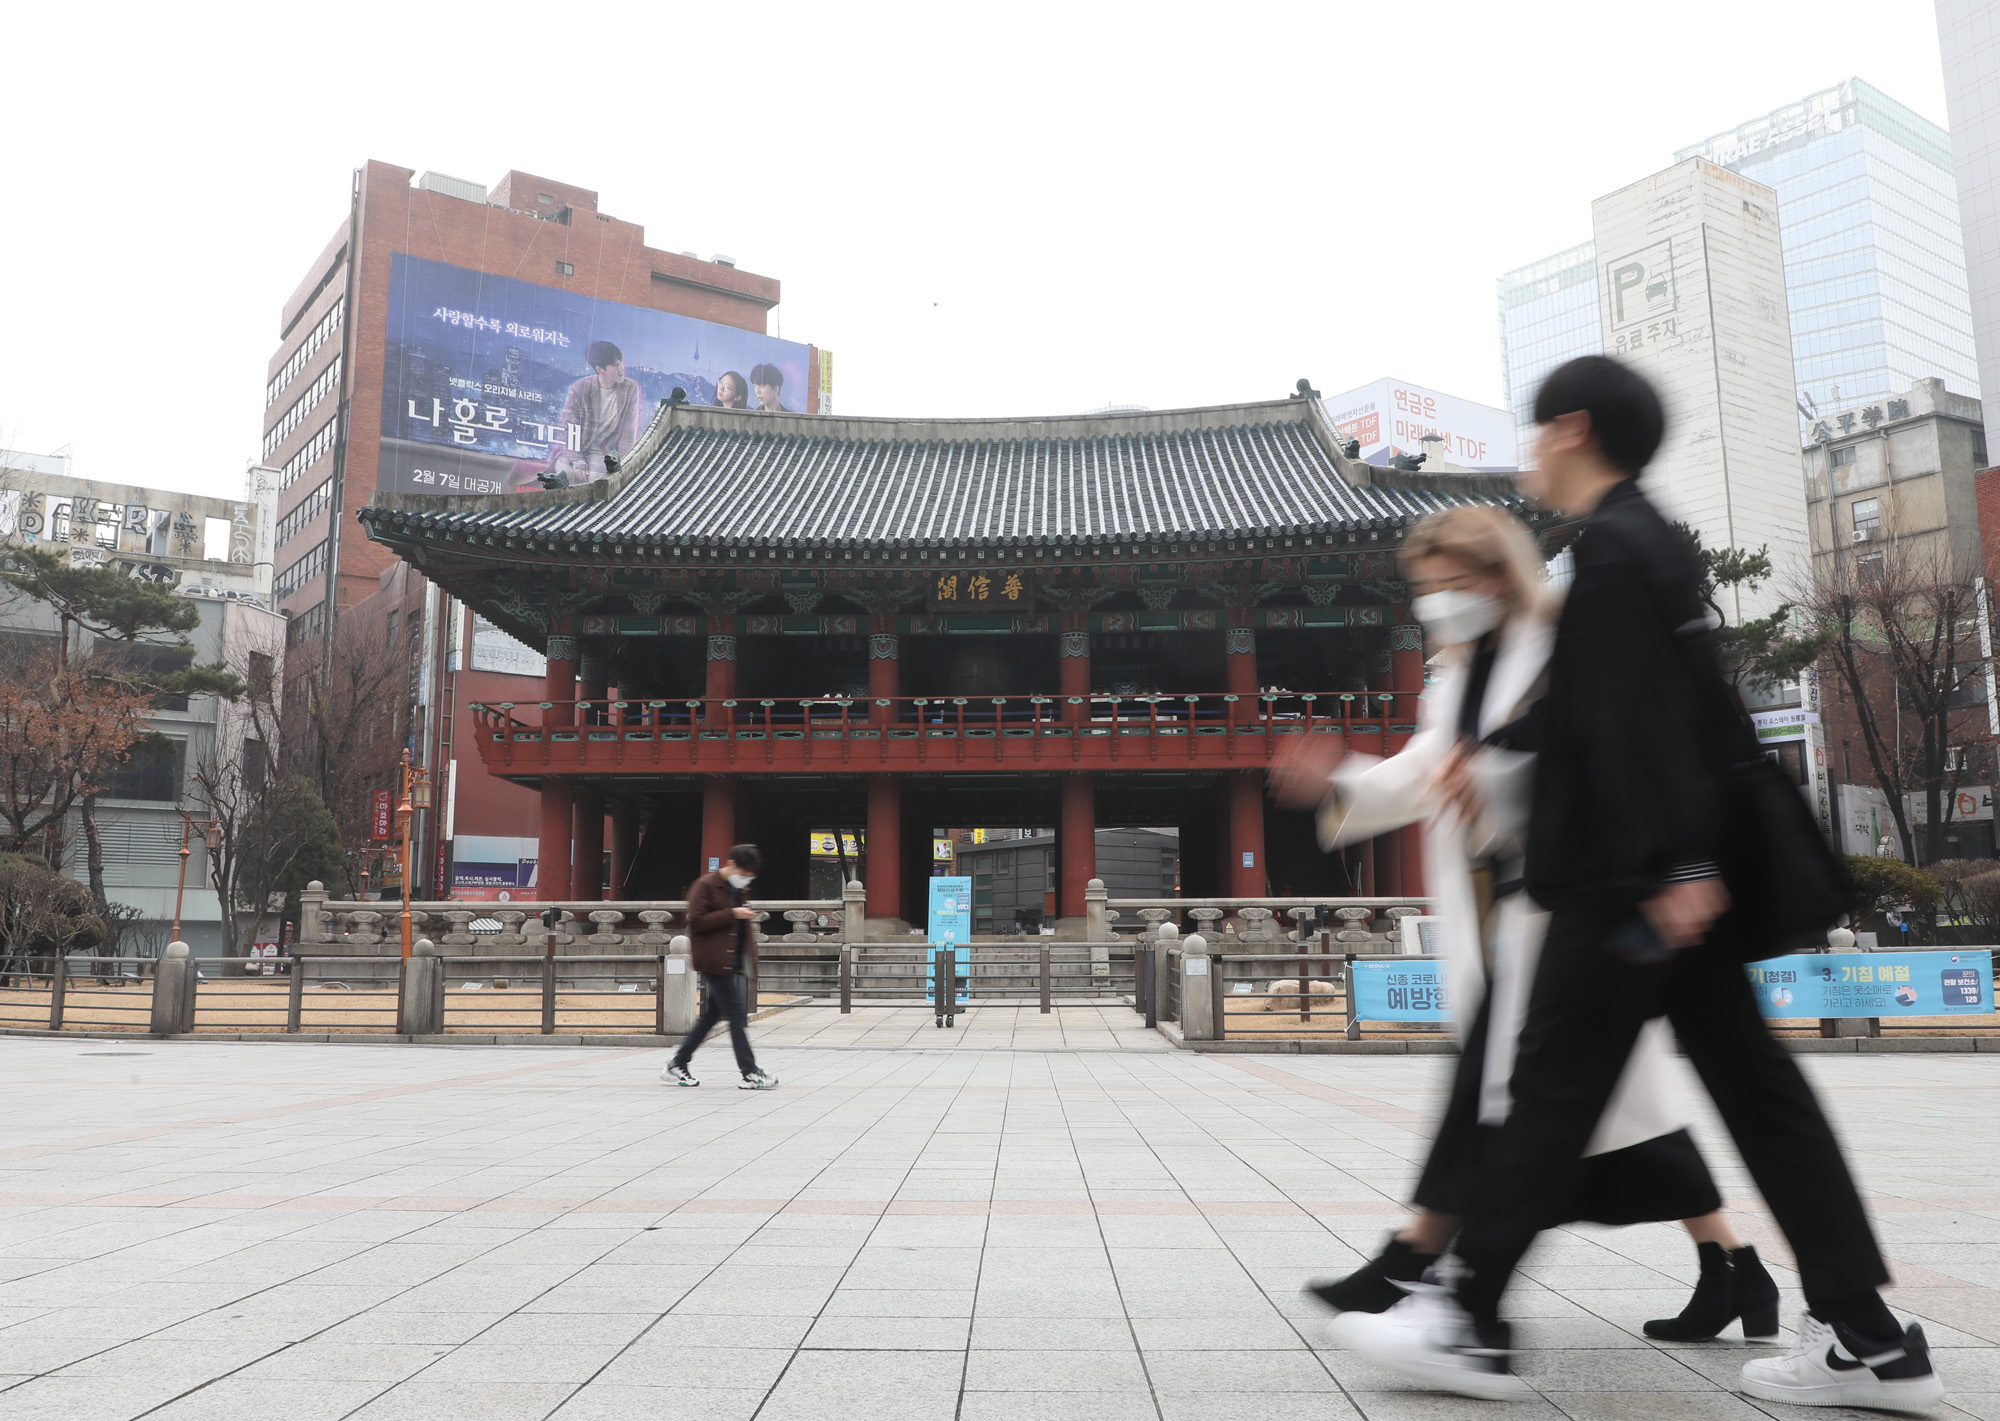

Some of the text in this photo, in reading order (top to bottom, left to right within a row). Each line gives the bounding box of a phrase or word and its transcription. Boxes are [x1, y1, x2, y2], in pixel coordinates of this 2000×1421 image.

[1704, 106, 1834, 166] IRAE ASSET
[1614, 262, 1644, 323] P
[433, 307, 570, 347] 사랑할수록 외로워지는
[1615, 317, 1676, 355] 유료 주차
[450, 377, 542, 402] 넷플릭스 오리지널 시리즈
[1394, 388, 1436, 419] 연금은
[408, 398, 581, 452] 나 홀로 그대
[1360, 416, 1377, 429] TDF
[1361, 430, 1377, 443] TDF
[1456, 435, 1486, 461] TDF
[413, 469, 435, 485] 2월
[439, 473, 460, 489] 7일
[465, 477, 502, 495] 대공개
[1387, 974, 1408, 985] 신종
[1748, 965, 1910, 983] 기(청결) 3. 기침 예절
[1822, 985, 1892, 996] 기침은 옷소매로
[1823, 998, 1886, 1009] 가리고 하세요!
